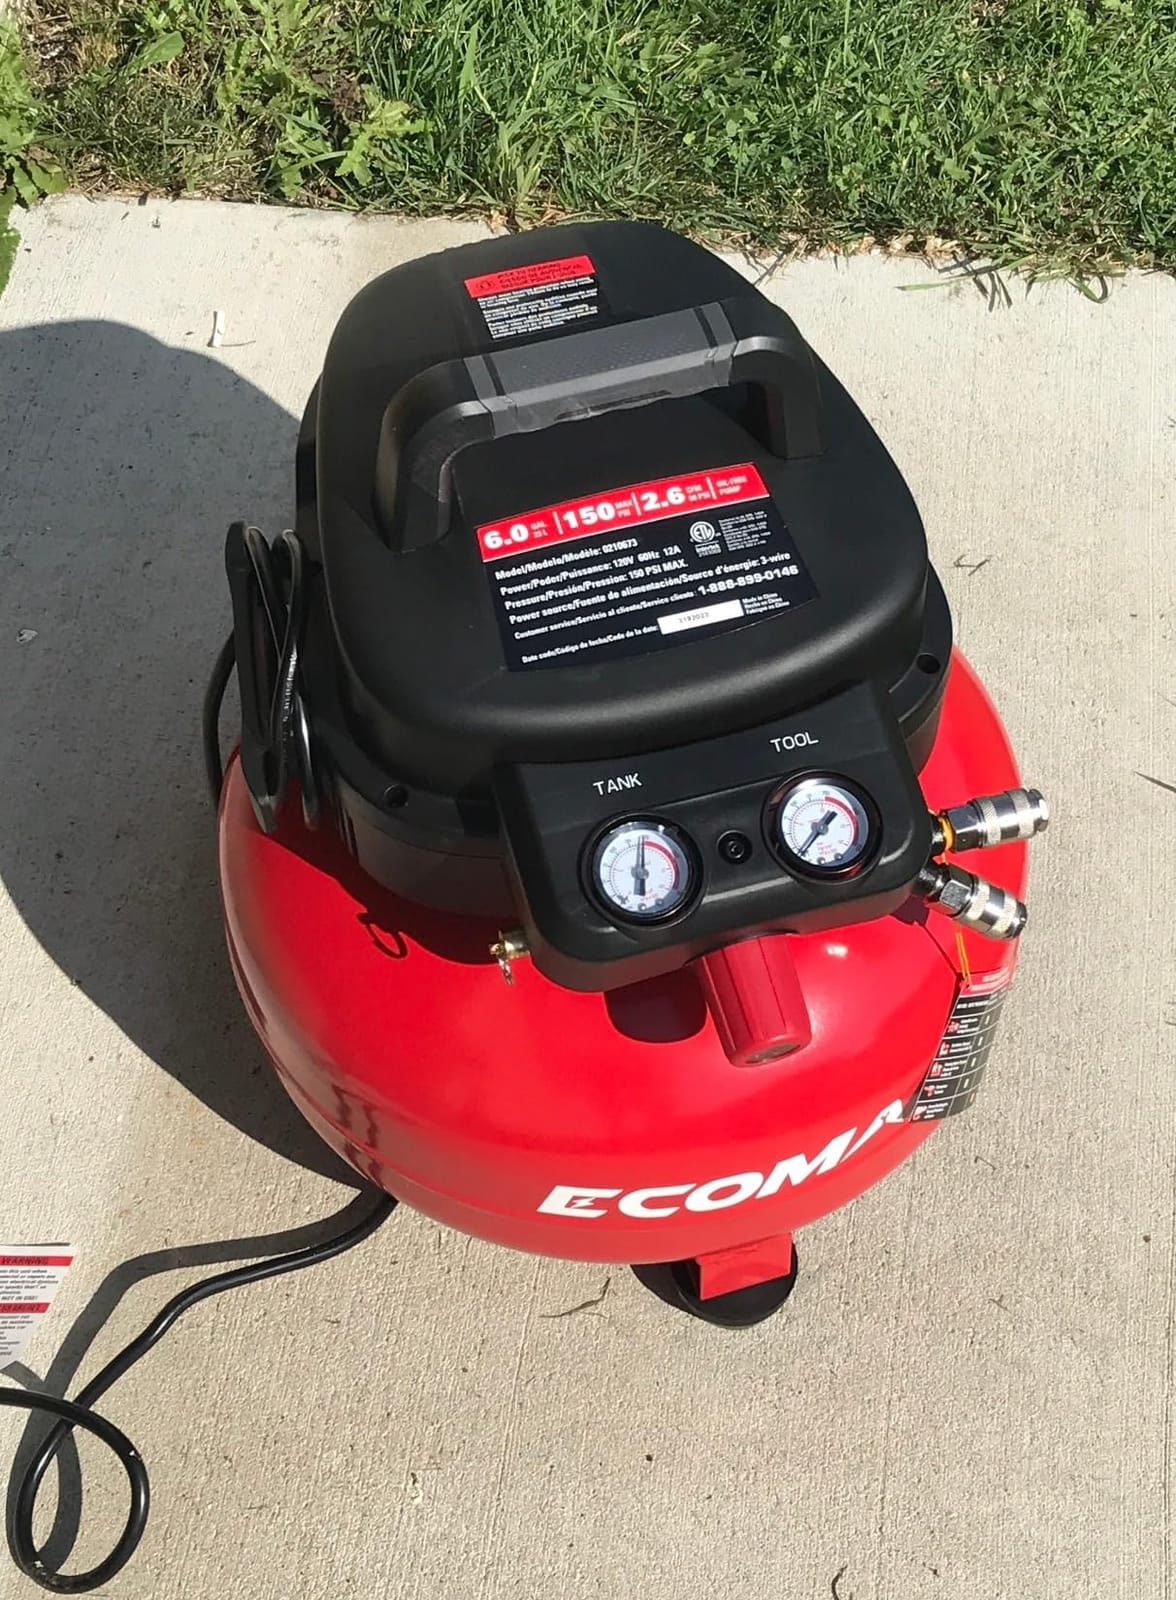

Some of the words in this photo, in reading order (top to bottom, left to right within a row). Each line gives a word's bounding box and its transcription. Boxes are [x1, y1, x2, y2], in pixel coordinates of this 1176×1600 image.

[640, 486, 686, 511] 2.6
[719, 485, 741, 496] PUMP
[562, 501, 615, 529] 150
[614, 499, 633, 510] MAX
[617, 508, 631, 518] PSI
[484, 523, 528, 549] 6.0
[530, 520, 547, 530] GAL
[494, 546, 602, 580] Model/Modelo/Modèle:
[602, 538, 638, 554] 0210673
[500, 561, 613, 596] Power/Poder/Puissance:
[613, 555, 634, 568] 120V
[637, 550, 660, 562] 60Hz
[663, 544, 681, 556] 12A
[504, 573, 628, 610] Pressure/Presión/Pression:
[628, 568, 645, 579] 150
[645, 564, 662, 576] PSI
[662, 558, 689, 572] MAX.
[509, 610, 540, 624] Power
[541, 594, 606, 616] source/Fuente
[621, 570, 714, 597] alimentación/Source
[715, 558, 760, 576] d'énergie:
[760, 552, 791, 565] 3-wire
[514, 626, 549, 639] Customer
[549, 612, 607, 631] service/Servicio
[697, 564, 799, 595] 1-888-899-0146
[770, 731, 819, 753] TOOL
[592, 772, 642, 796] TANK
